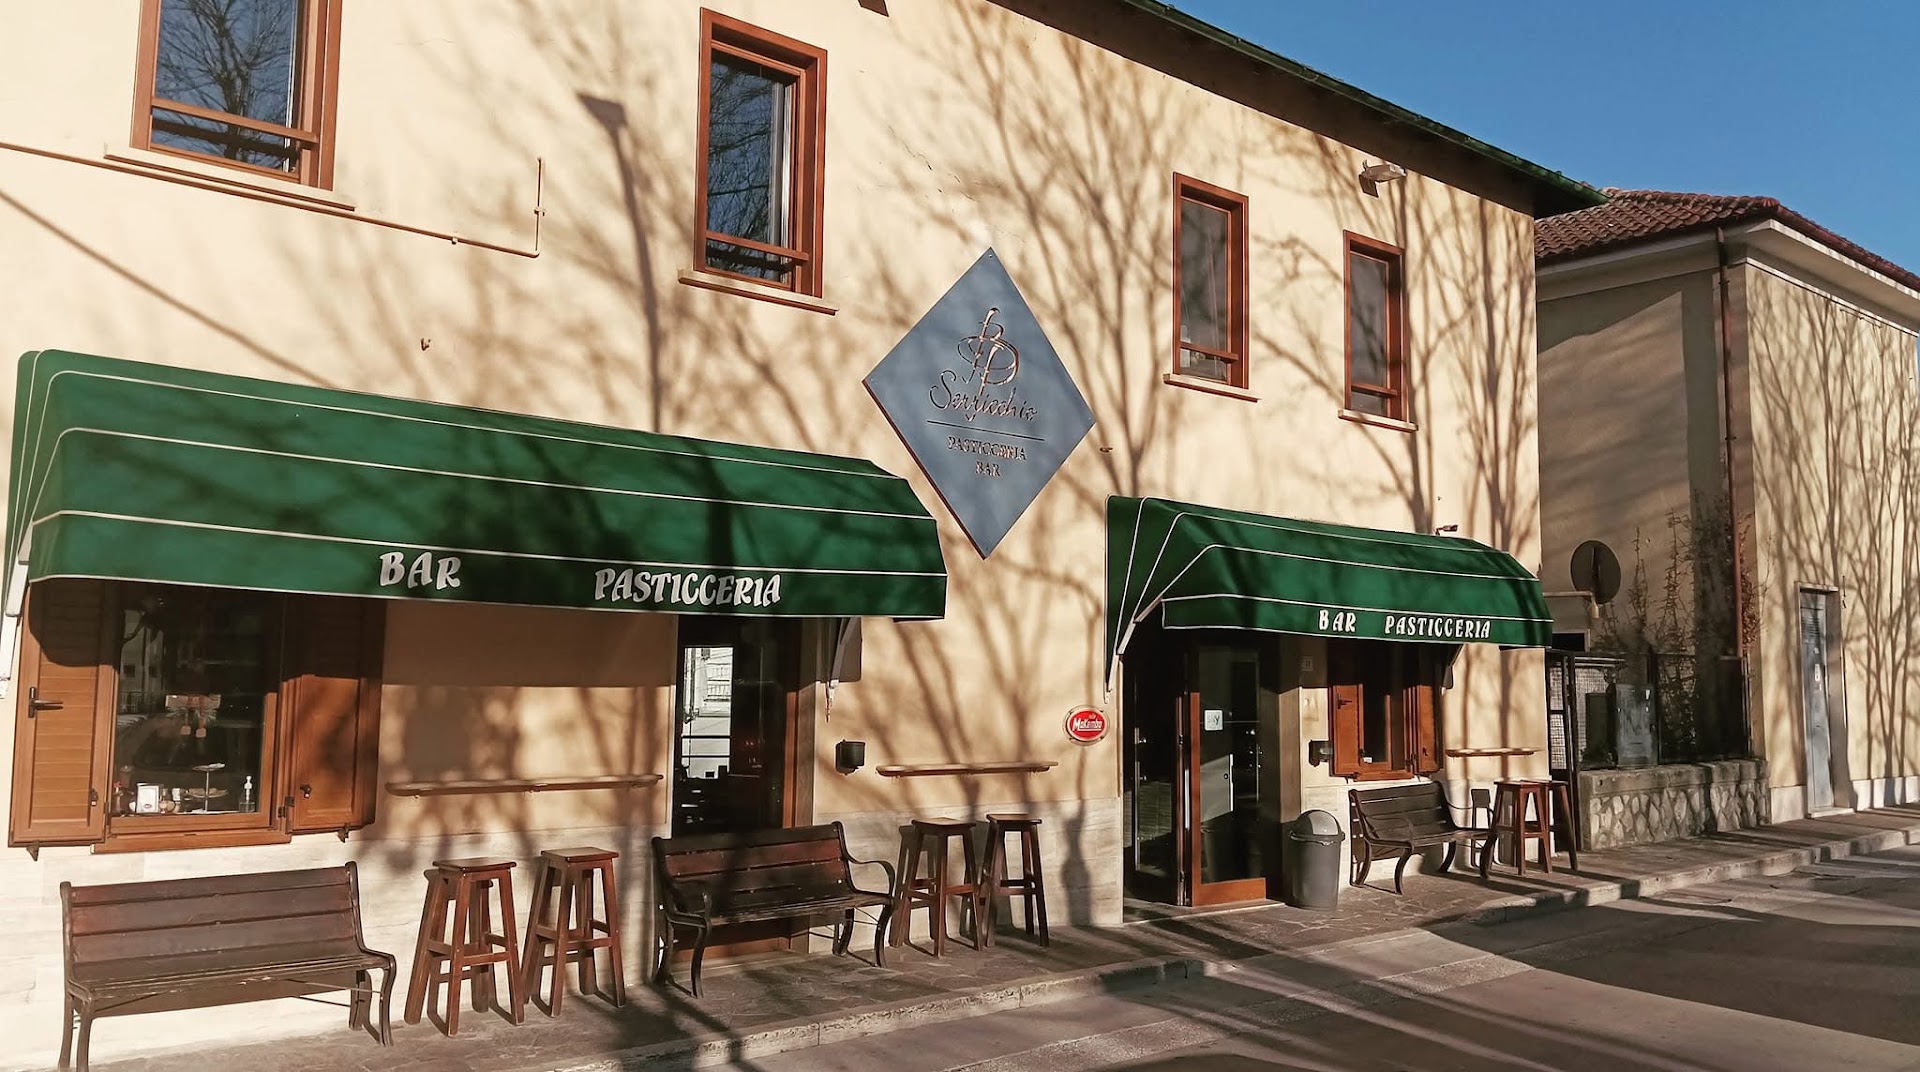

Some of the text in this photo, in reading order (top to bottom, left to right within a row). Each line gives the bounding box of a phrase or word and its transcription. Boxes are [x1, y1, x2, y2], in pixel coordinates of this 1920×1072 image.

[947, 436, 1028, 461] PASTICCERIA
[975, 460, 1001, 477] BAR
[378, 551, 782, 607] BAR PASTICCERIA
[1318, 609, 1492, 639] BAR PASTICCERIA
